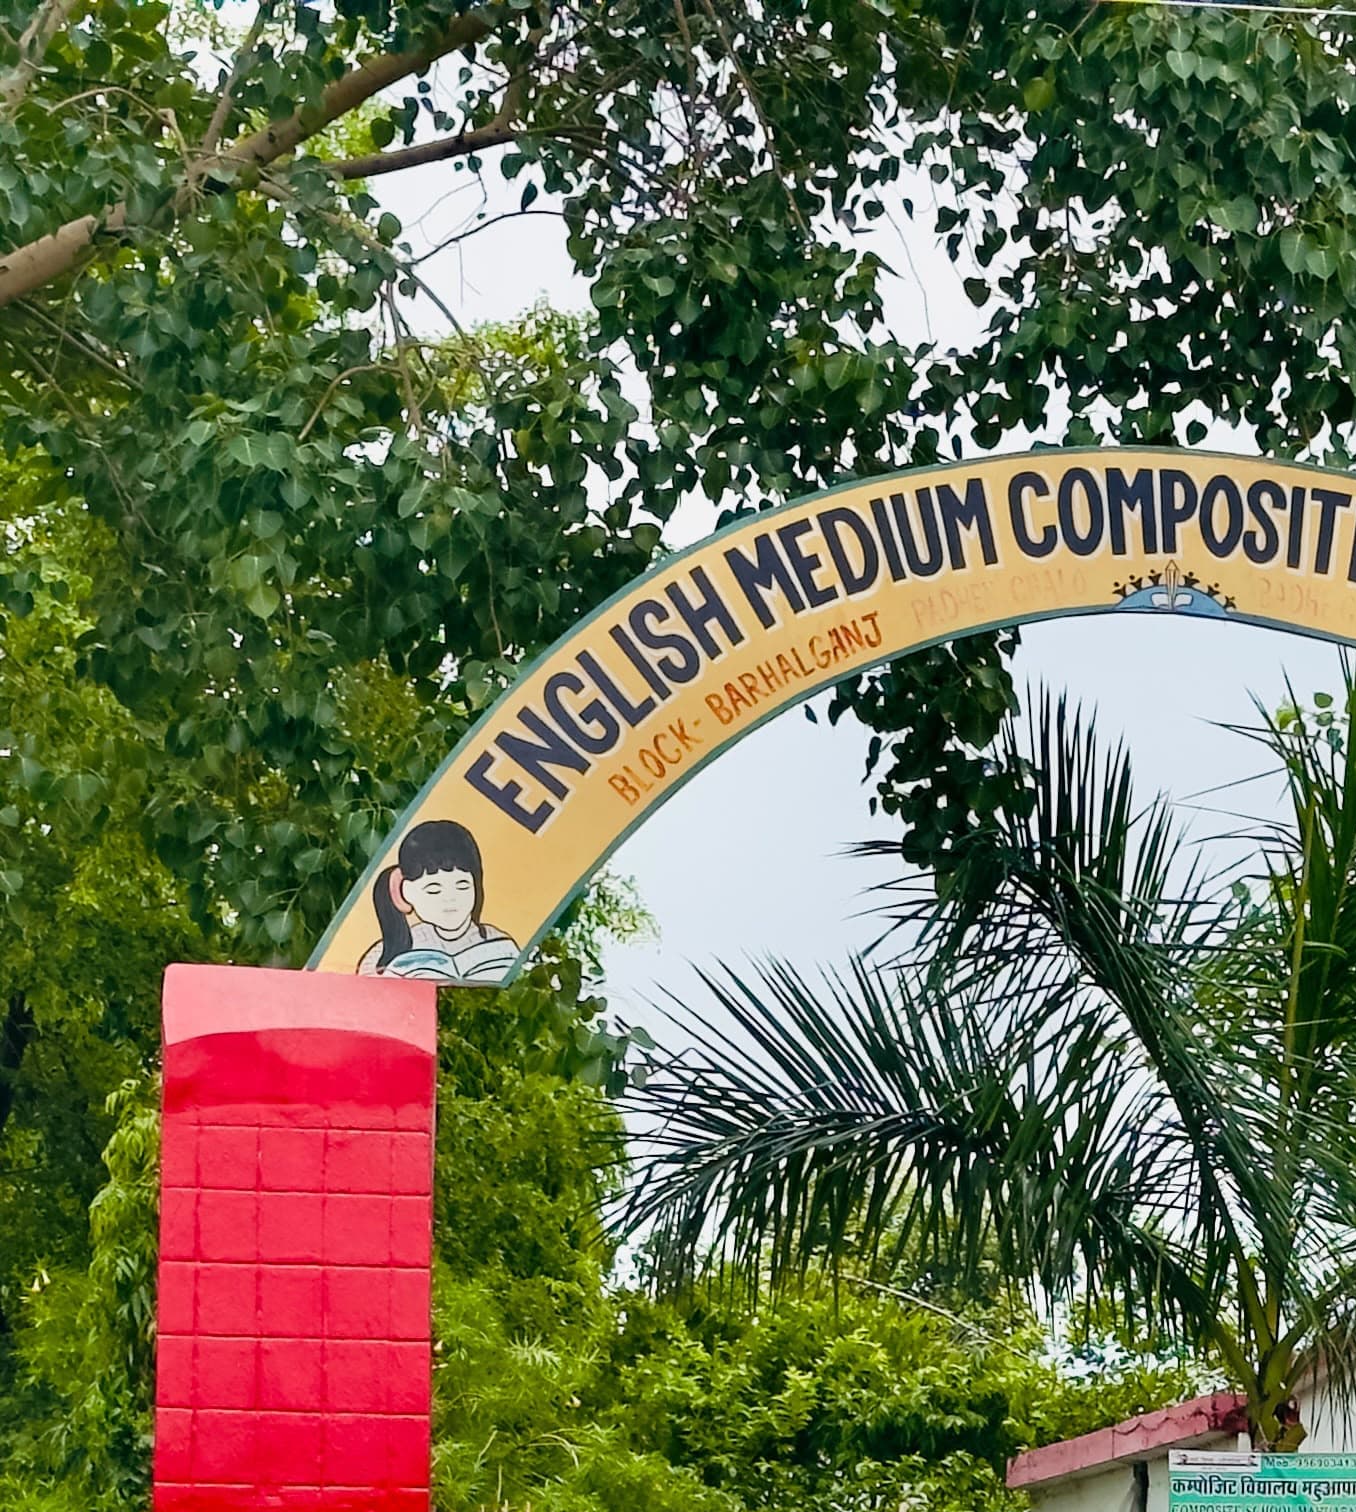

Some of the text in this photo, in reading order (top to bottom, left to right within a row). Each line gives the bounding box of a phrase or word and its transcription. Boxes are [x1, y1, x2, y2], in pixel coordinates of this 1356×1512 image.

[464, 564, 743, 835] ENGLISH
[723, 477, 999, 631] MEDIUM
[705, 611, 885, 728] BARHALGANJ
